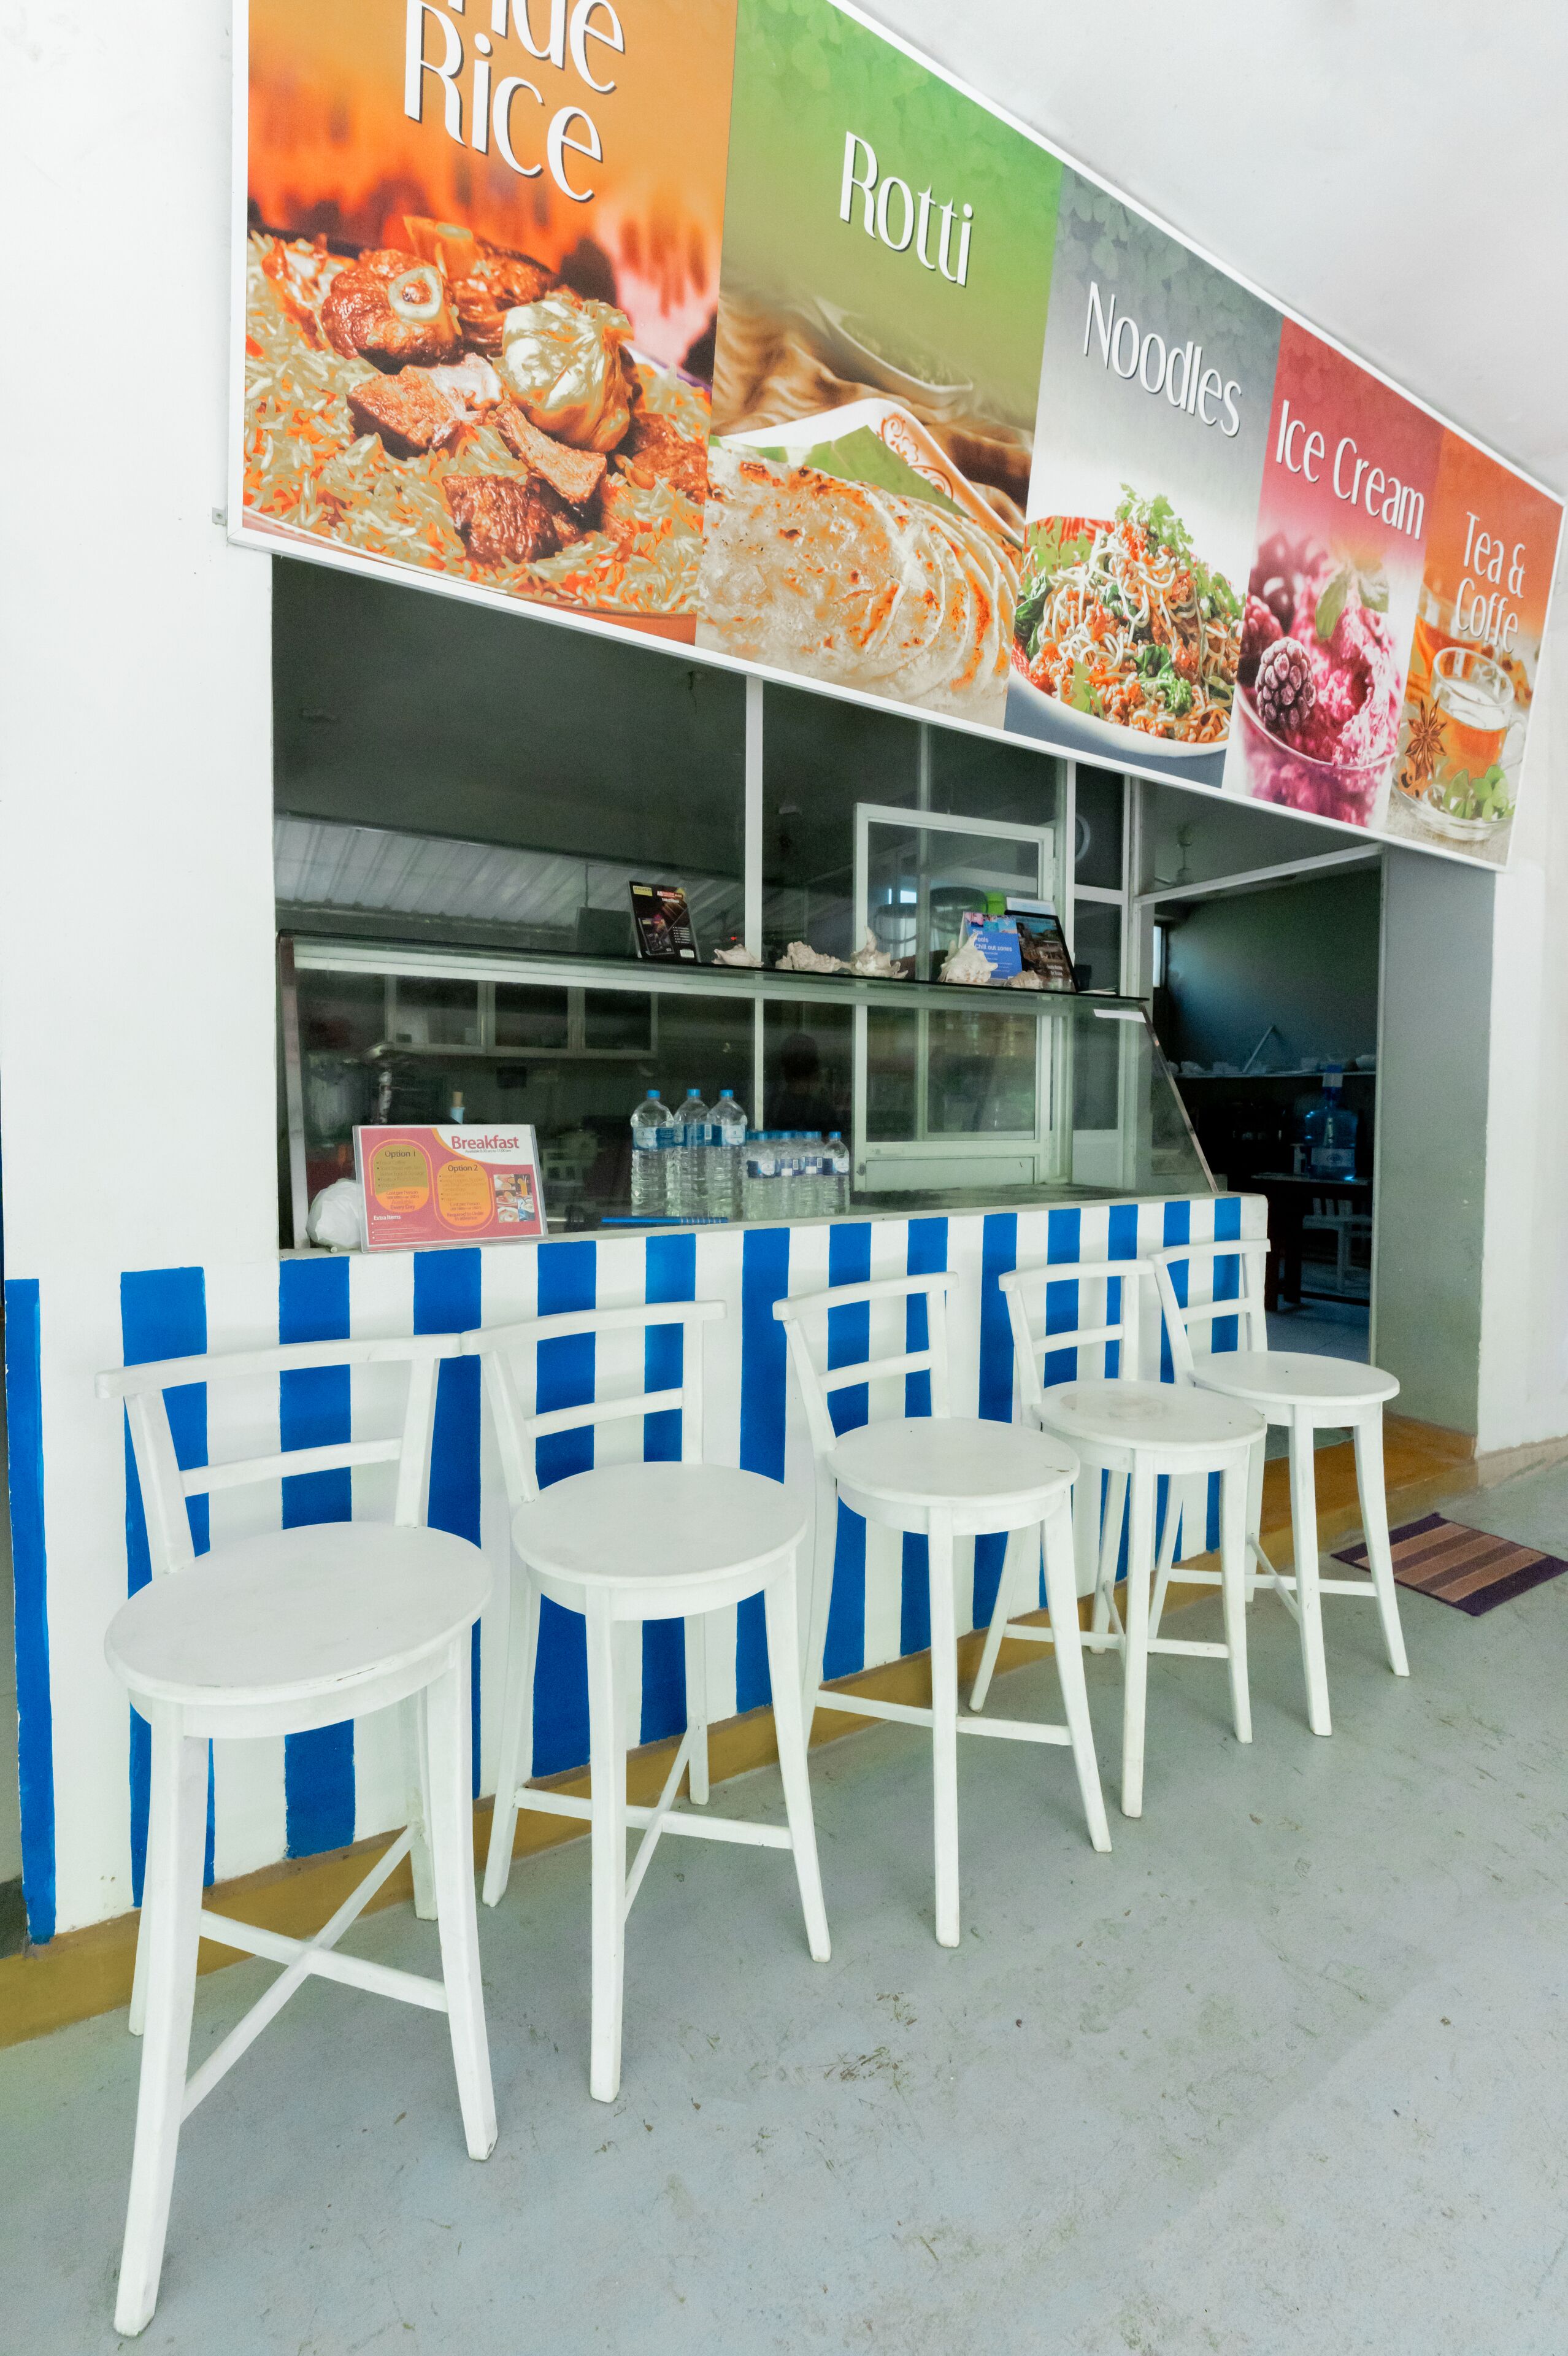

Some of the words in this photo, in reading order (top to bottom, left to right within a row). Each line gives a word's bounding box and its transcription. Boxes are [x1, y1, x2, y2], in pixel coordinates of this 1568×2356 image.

[404, 0, 603, 202] Rice
[839, 131, 974, 287] Rotti
[1083, 280, 1243, 437] Noodles
[1276, 399, 1325, 483] Ice
[1333, 437, 1424, 541] Cream
[1464, 511, 1505, 585] Tea
[1507, 542, 1526, 599] &
[1455, 577, 1519, 654] Coffe
[384, 1150, 411, 1159] Option
[447, 1165, 473, 1173] Option
[451, 1134, 520, 1150] Breakfast
